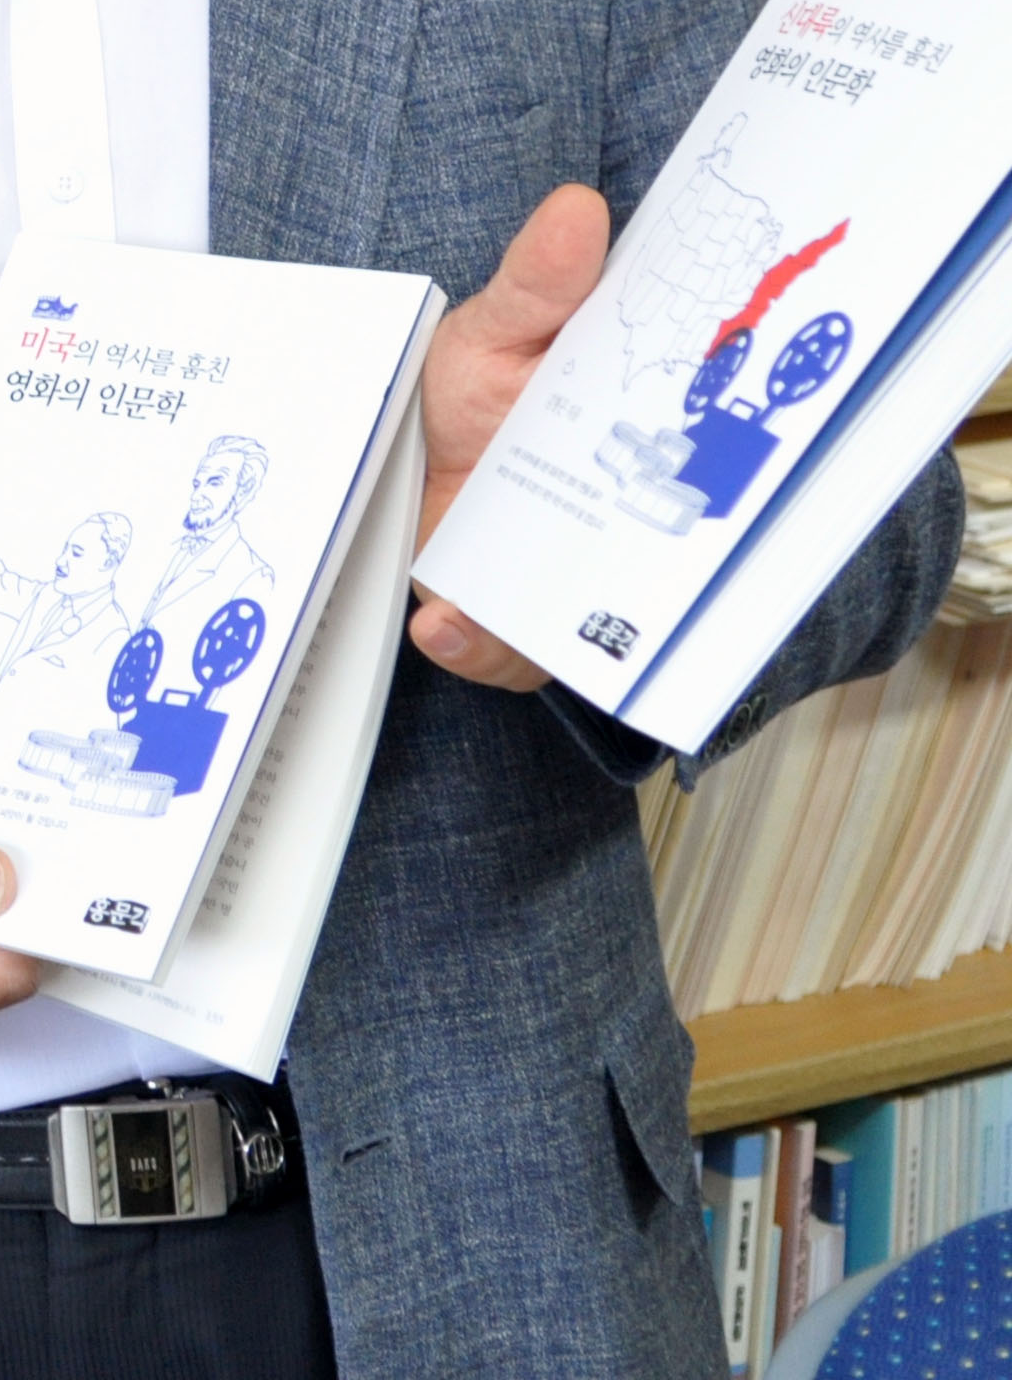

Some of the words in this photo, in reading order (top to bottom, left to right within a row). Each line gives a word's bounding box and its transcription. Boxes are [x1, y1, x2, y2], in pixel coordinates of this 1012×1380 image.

[750, 44, 811, 87] 영화의
[803, 57, 877, 106] 인문학
[851, 21, 909, 61] 역사를
[904, 36, 954, 74] 훔친
[21, 327, 99, 366] 미국의
[106, 342, 175, 377] 역사를
[181, 352, 231, 384] 훔친
[6, 370, 90, 411] 영화의
[99, 382, 188, 425] 인문학
